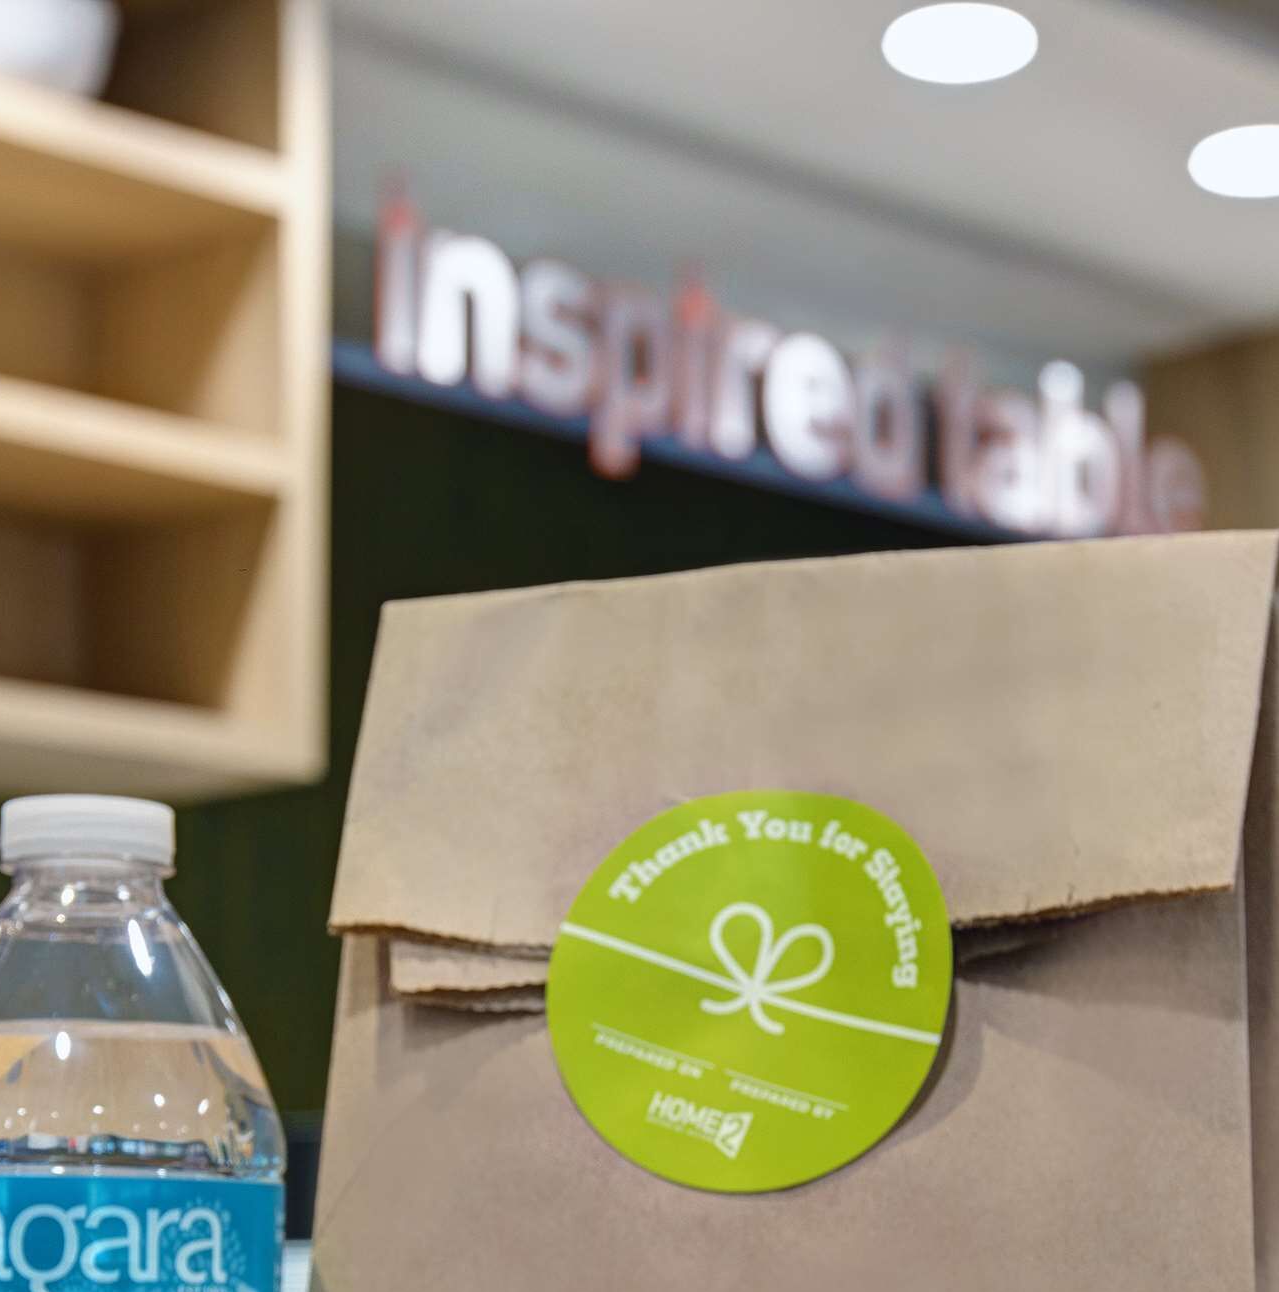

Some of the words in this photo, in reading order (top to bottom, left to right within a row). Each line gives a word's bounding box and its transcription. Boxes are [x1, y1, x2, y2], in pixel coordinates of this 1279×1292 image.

[376, 180, 916, 498] inspired
[608, 818, 730, 905] Thank
[737, 809, 811, 842] You
[819, 820, 868, 860] for
[863, 848, 922, 989] Staying
